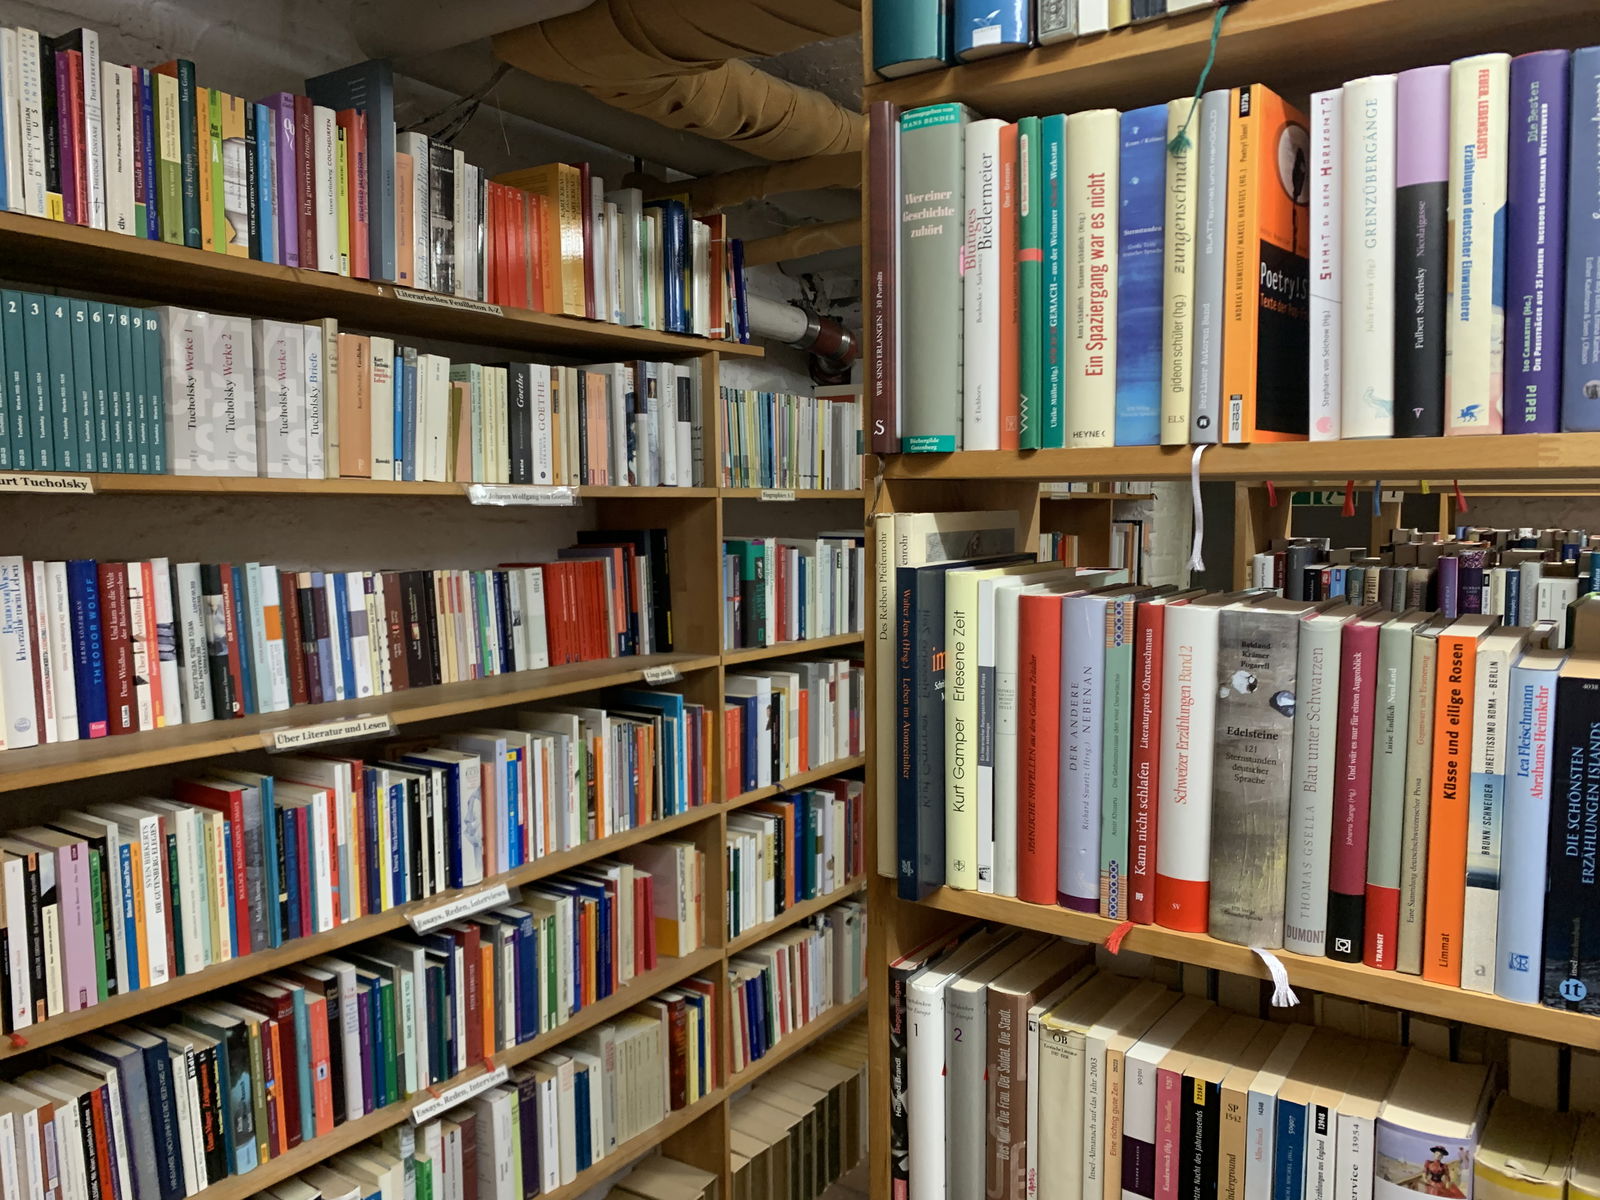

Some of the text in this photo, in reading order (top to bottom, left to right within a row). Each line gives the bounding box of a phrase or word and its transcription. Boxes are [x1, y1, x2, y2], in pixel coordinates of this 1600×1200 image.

[1476, 100, 1490, 159] LEBENSLUST!
[1527, 81, 1540, 143] Die Besten
[924, 190, 952, 201] einer
[1362, 98, 1377, 249] GRENZÜBERGÄNGE
[903, 206, 955, 222] Geschichte
[977, 152, 993, 250] Biedermeier
[911, 224, 943, 238] zuhört
[964, 208, 981, 271] Blutiges
[1050, 210, 1058, 246] Weimarer
[1460, 144, 1477, 322] Erzählungen deutscher Einwanderer
[1085, 173, 1108, 376] Ein Spaziergang war es nicht
[1414, 200, 1427, 349] Fulbert Steffensky Nicolaigasse
[1533, 157, 1547, 357] PREISTRÄGER BACHMANN
[8, 301, 17, 313] 2
[31, 303, 39, 315] 3
[55, 306, 63, 318] 4
[76, 311, 84, 322] 5
[93, 311, 101, 322] 6
[108, 314, 115, 324] 7
[120, 314, 127, 326] 8
[133, 317, 140, 328] 9
[397, 290, 449, 305] Literarisches
[146, 319, 157, 331] 10
[875, 315, 883, 358] ERLANGEN
[222, 343, 232, 376] Werke
[1171, 320, 1184, 393] gideon schüler
[184, 337, 197, 431] Tucholsky Werke
[224, 380, 236, 433] Tucholsky
[277, 349, 290, 437] Tucholsky Werke
[309, 353, 320, 437] Tucholsky Briefe
[516, 372, 524, 408] Goethe
[537, 381, 545, 431] GOETHE
[1321, 373, 1332, 407] Stephanie
[1525, 385, 1537, 422] PIPER
[20, 477, 88, 490] Tucholsky
[879, 531, 888, 640] Des Rebben Pfeifenrohr
[85, 577, 101, 685] THEODOR WOLFF
[110, 626, 118, 640] Und
[120, 680, 128, 697] Peter
[952, 610, 967, 813] Kurt Gamper Erlesene Zeit
[1082, 666, 1092, 733] NEBENAN
[1385, 668, 1397, 754] Luise Endlich NeuLand
[277, 721, 387, 744] Über Literatur und Lesen
[903, 678, 911, 779] Leben Atomzeitalter
[1069, 682, 1079, 771] DER ANDERE
[1173, 654, 1194, 805] Schweizer Erzählungen Band
[1227, 726, 1279, 740] Edelsteine
[1347, 651, 1363, 781] Und für einen Augenblick
[1443, 643, 1463, 800] Küsse und eilige Rosen
[1485, 661, 1499, 775] DIRETTISSIMO ROMA BERLIN
[1517, 685, 1534, 778] Lea Fleischmann
[1530, 685, 1549, 800] Abrahams Heimkehr
[1134, 628, 1153, 876] Kann nicht schlafen Literaturpreis Ohrenschmaus
[1225, 752, 1277, 766] Sternstunden
[1232, 764, 1269, 775] deutscher
[1028, 748, 1036, 855] SPANISCHE NOVELLEN
[1234, 773, 1265, 785] Sprache
[1300, 647, 1324, 919] THOMAS GSELLA Blau unter Schwarzen
[1566, 746, 1584, 857] DIE SCHÖNSTEN
[143, 825, 152, 889] SVEN BIRKERTS
[1408, 778, 1421, 907] Sammlung Prosa
[1581, 783, 1600, 884] ERZÄHLUNGEN
[150, 823, 162, 914] DIE GUTENBERG ELEGIEN
[445, 905, 470, 917] Reden,
[1286, 925, 1325, 943] DUMONT
[1375, 933, 1384, 962] TRANSIT
[1438, 933, 1450, 968] Limmat
[953, 1027, 963, 1043] 2
[444, 1090, 469, 1103] Reden,
[996, 1009, 1011, 1161] Das Die Frau. Der Soldat. Die Stadt.
[1089, 1057, 1099, 1109] das Jahr 2003
[1227, 1103, 1239, 1112] SP
[1109, 1082, 1120, 1157] Eine richtig gute Zeit
[1193, 1110, 1203, 1185] Nacht des Jahrtausends
[1317, 1139, 1326, 1160] England
